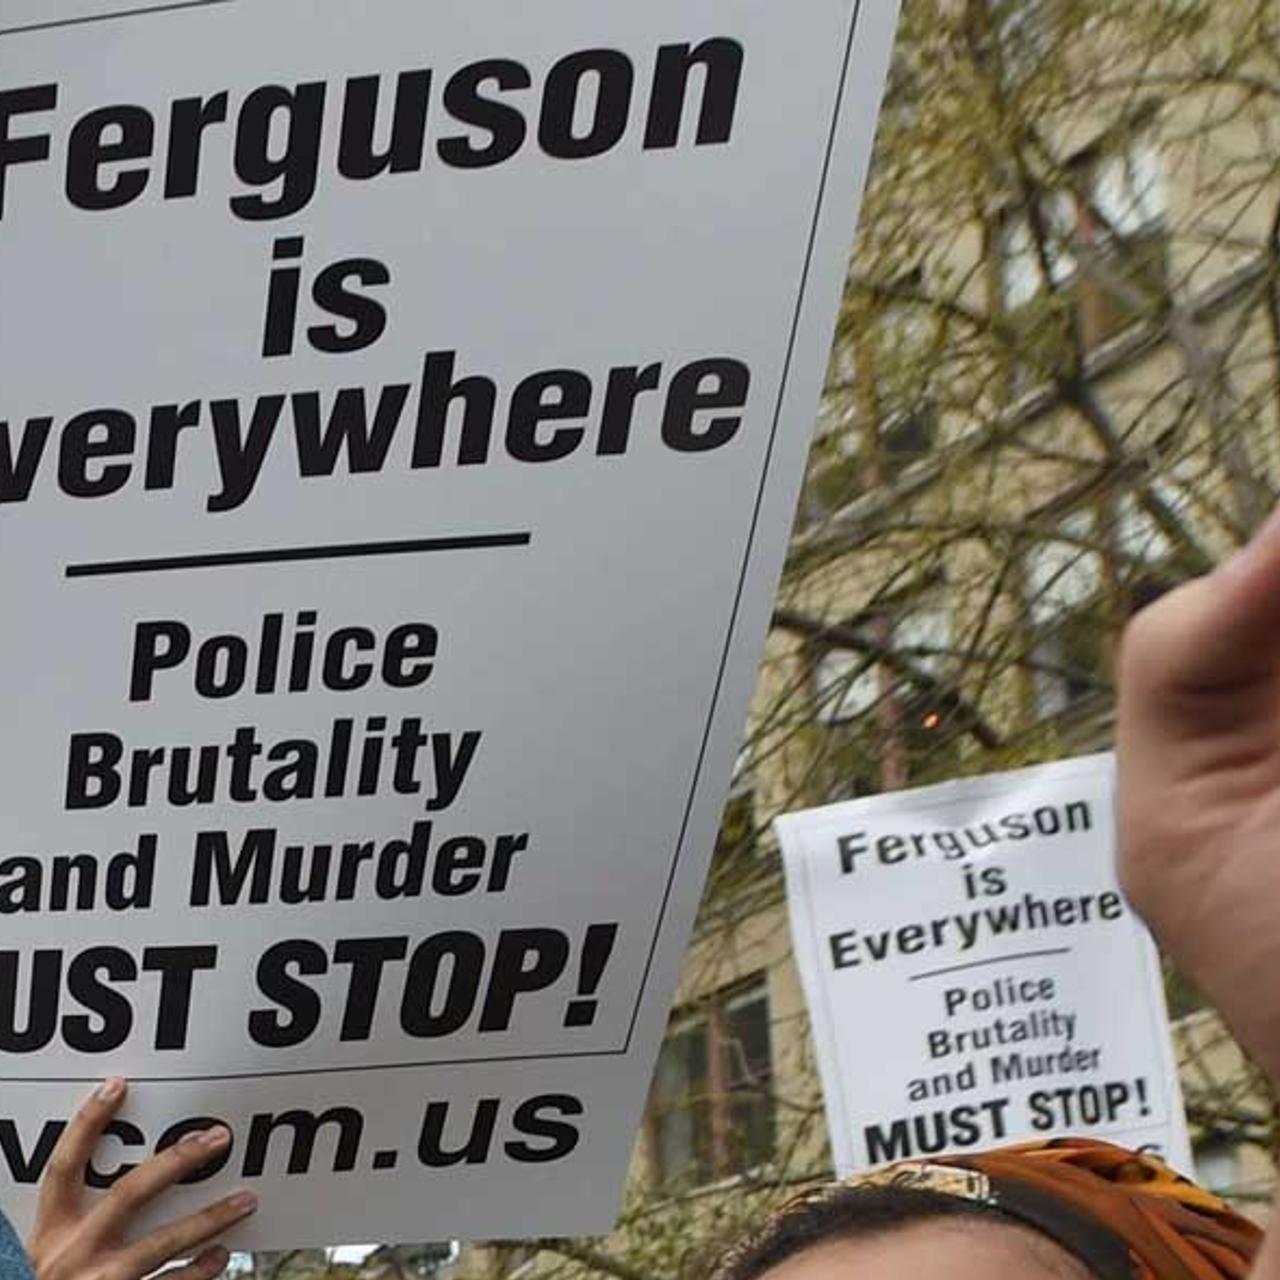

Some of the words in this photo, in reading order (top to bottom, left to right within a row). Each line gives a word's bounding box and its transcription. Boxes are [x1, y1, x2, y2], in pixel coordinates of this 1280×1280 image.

[261, 237, 391, 358] is
[128, 611, 438, 702] Police
[64, 717, 483, 811] Brutality
[188, 821, 528, 910] Murder
[836, 798, 1093, 875] Ferguson
[963, 863, 1008, 900] is
[829, 889, 1123, 970] Everywhere
[248, 923, 619, 1048] STOP!
[944, 975, 1056, 1017] Police
[906, 1063, 976, 1102] and
[991, 1045, 1101, 1085] Murder
[927, 1009, 1077, 1060] Brutality
[864, 1099, 1009, 1165] MUST
[1030, 1077, 1151, 1132] STOP!
